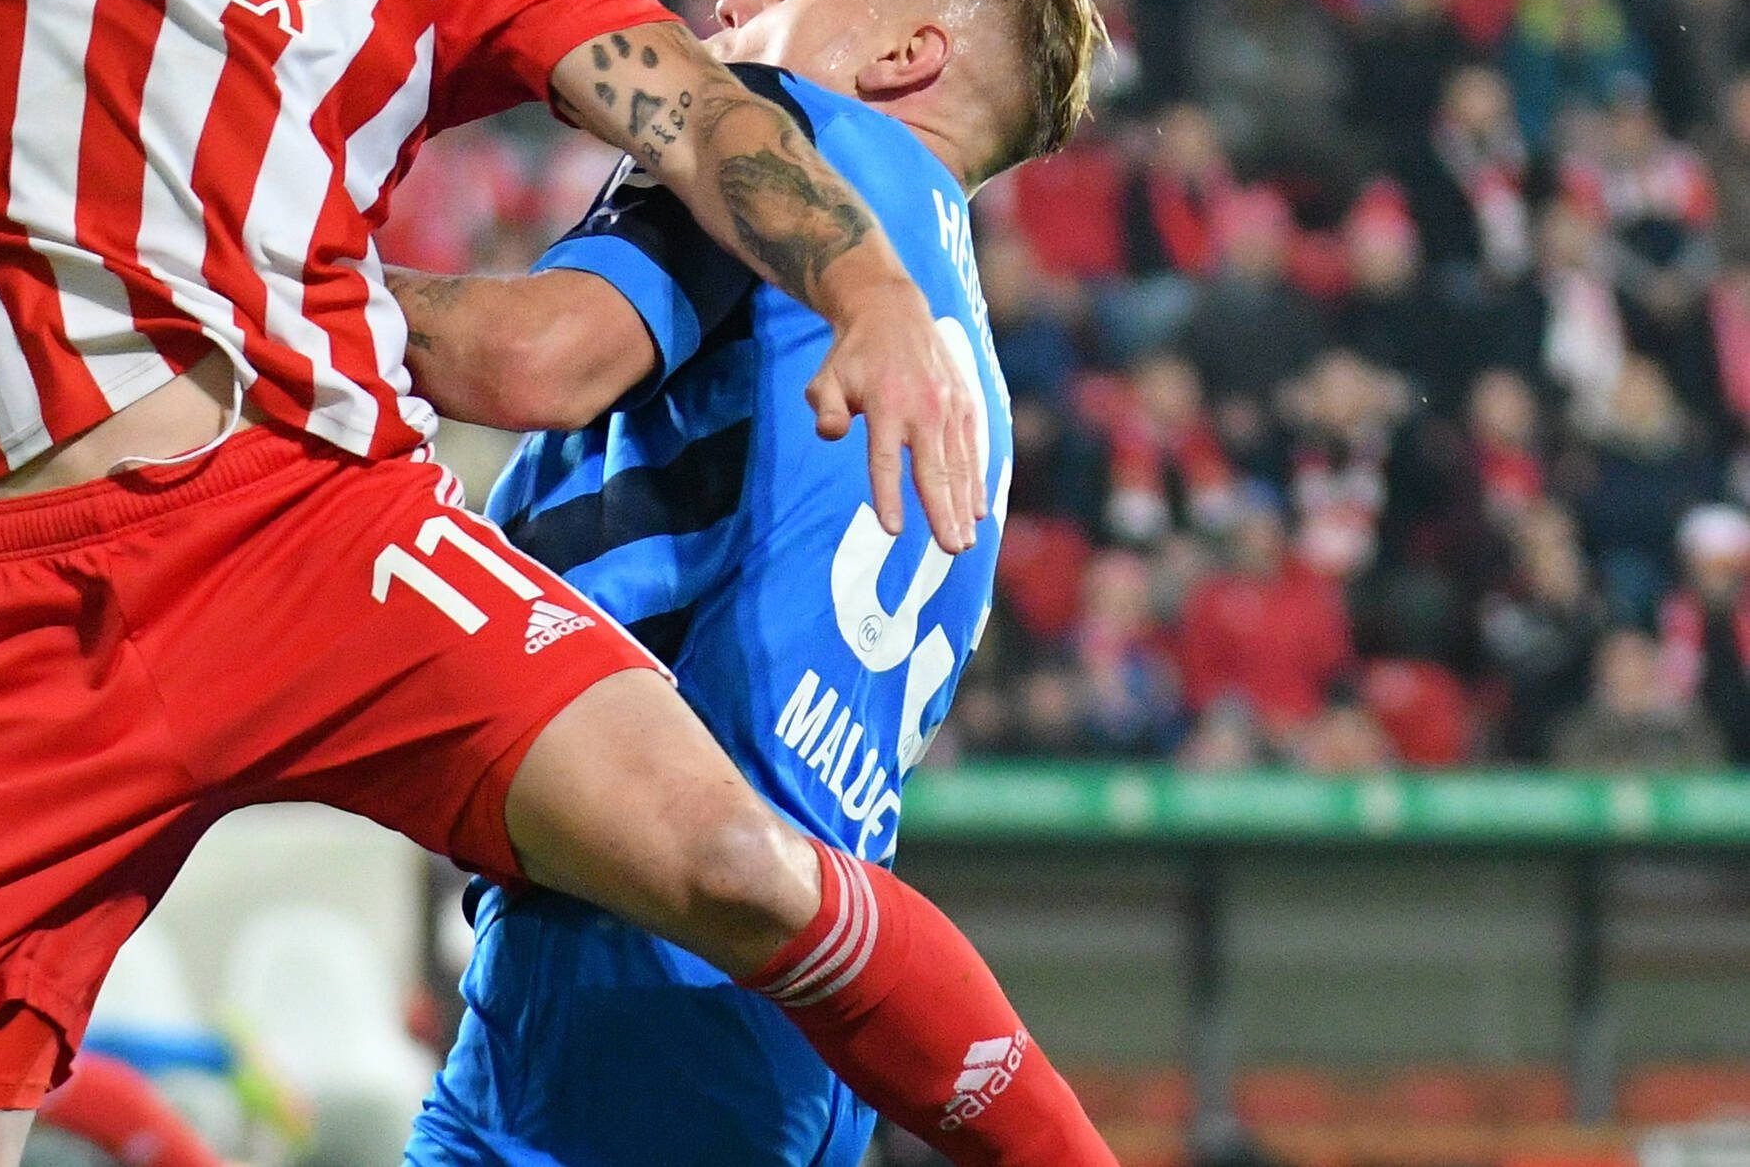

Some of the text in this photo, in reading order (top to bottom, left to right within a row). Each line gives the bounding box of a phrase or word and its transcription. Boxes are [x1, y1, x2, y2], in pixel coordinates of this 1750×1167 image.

[371, 515, 545, 635] 11
[524, 615, 596, 655] adidas
[940, 1029, 1030, 1131] adidas
